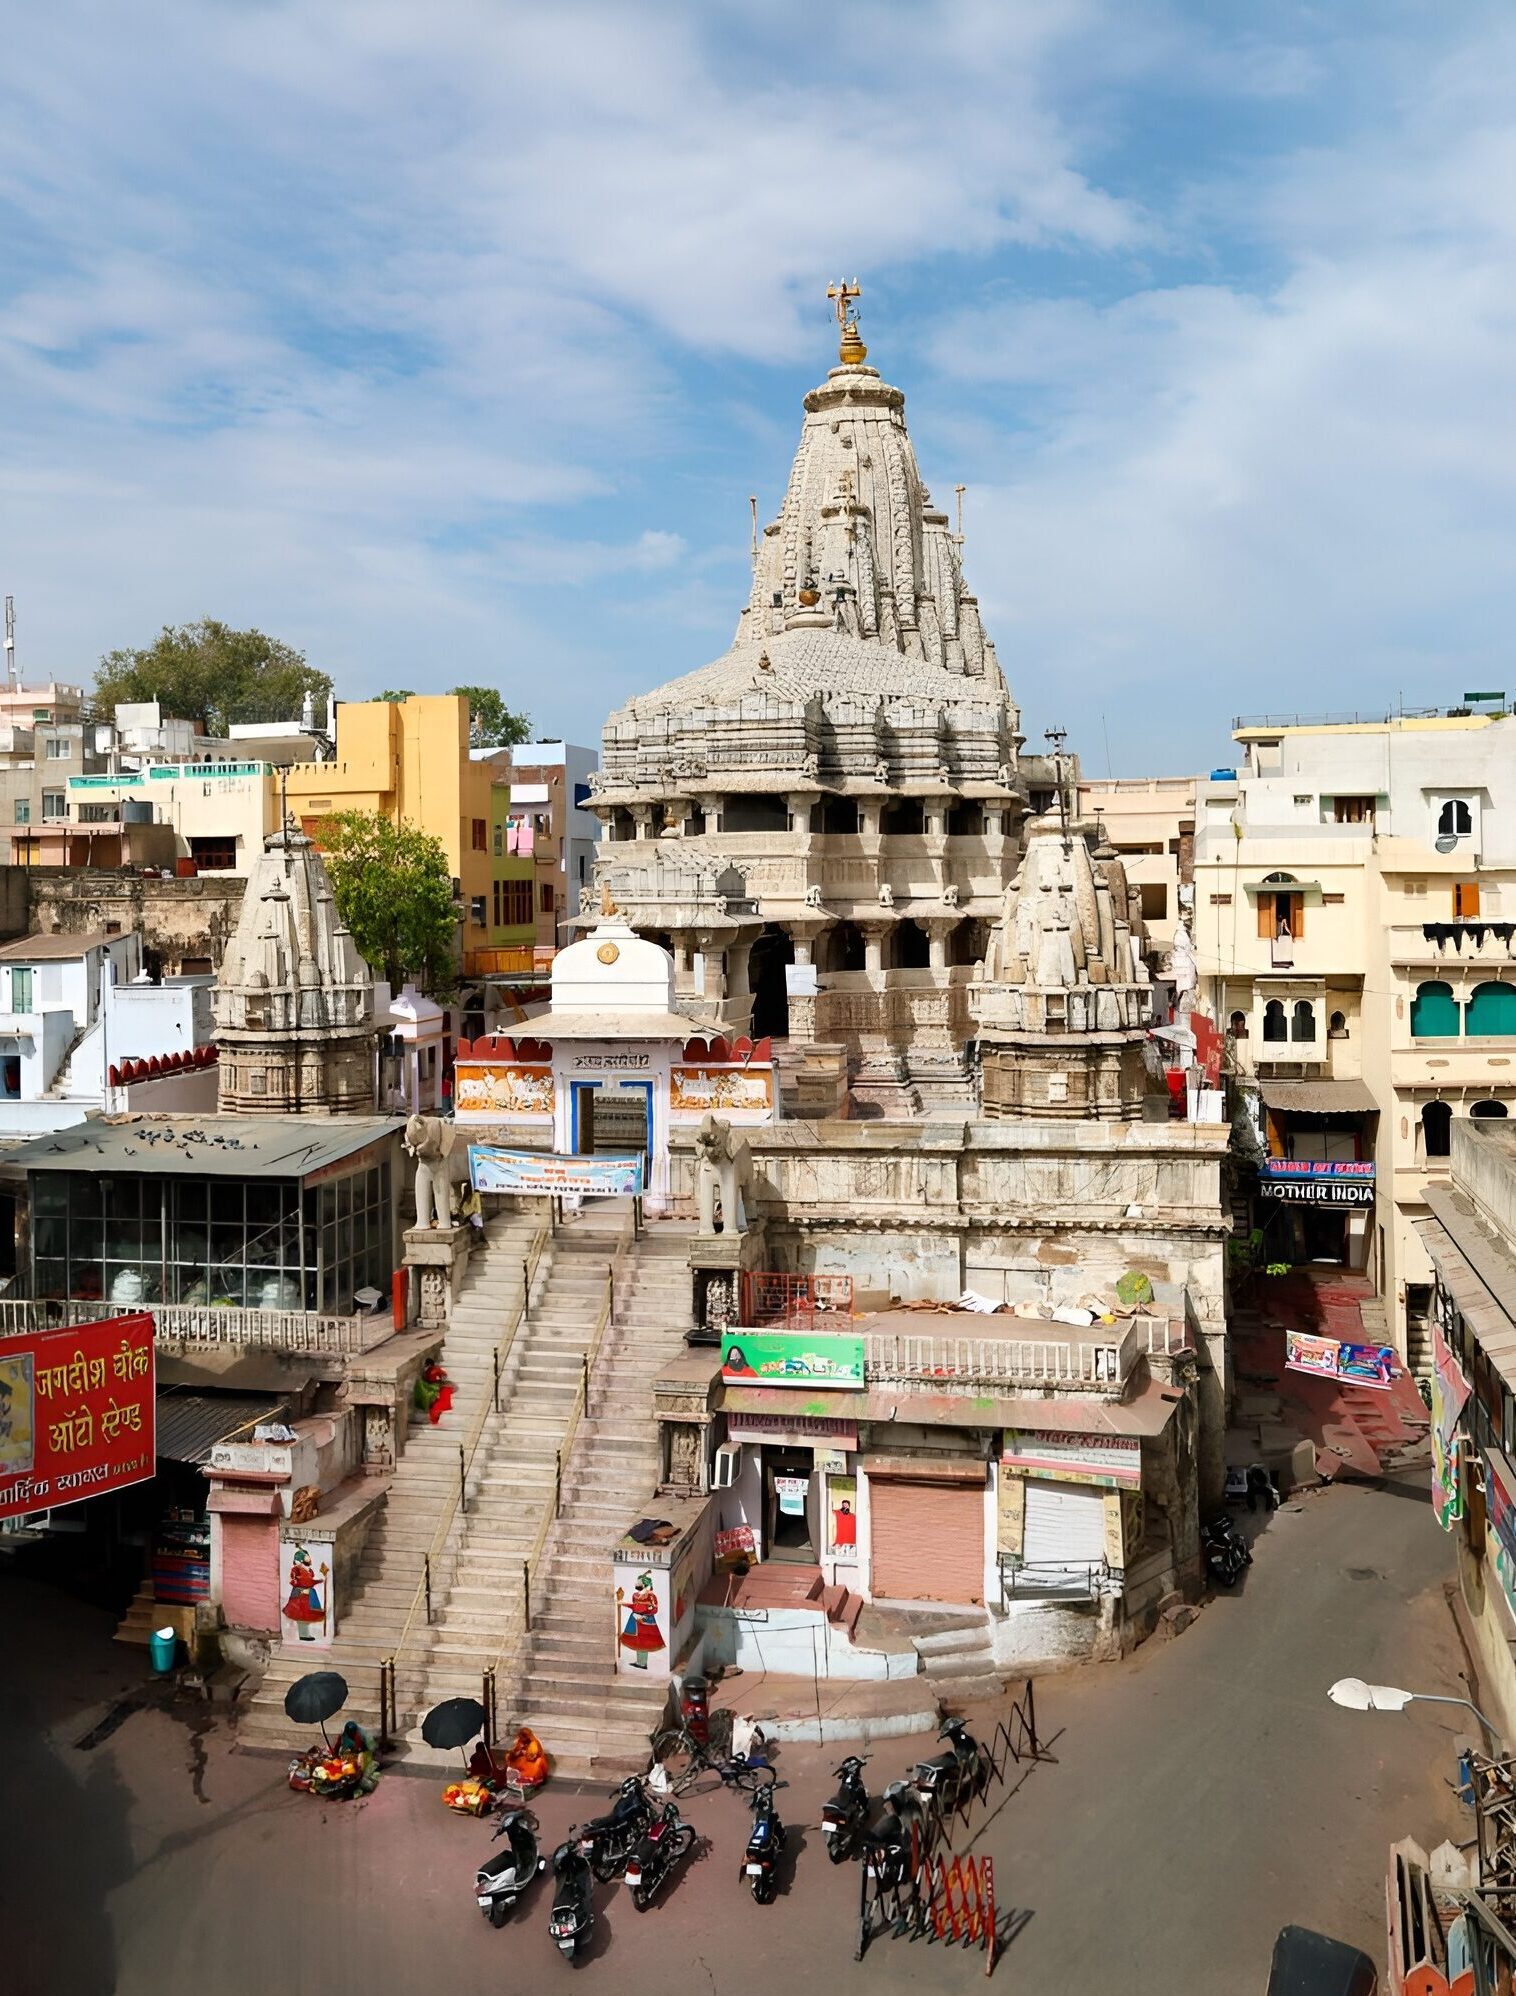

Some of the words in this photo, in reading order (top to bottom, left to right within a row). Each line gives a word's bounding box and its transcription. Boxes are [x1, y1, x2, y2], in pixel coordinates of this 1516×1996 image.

[1261, 1184, 1328, 1199] MOTHER
[1332, 1185, 1374, 1201] INDIA
[35, 1350, 106, 1399] जगदीश
[113, 1340, 149, 1382] चौक
[48, 1404, 94, 1452] ऑटो
